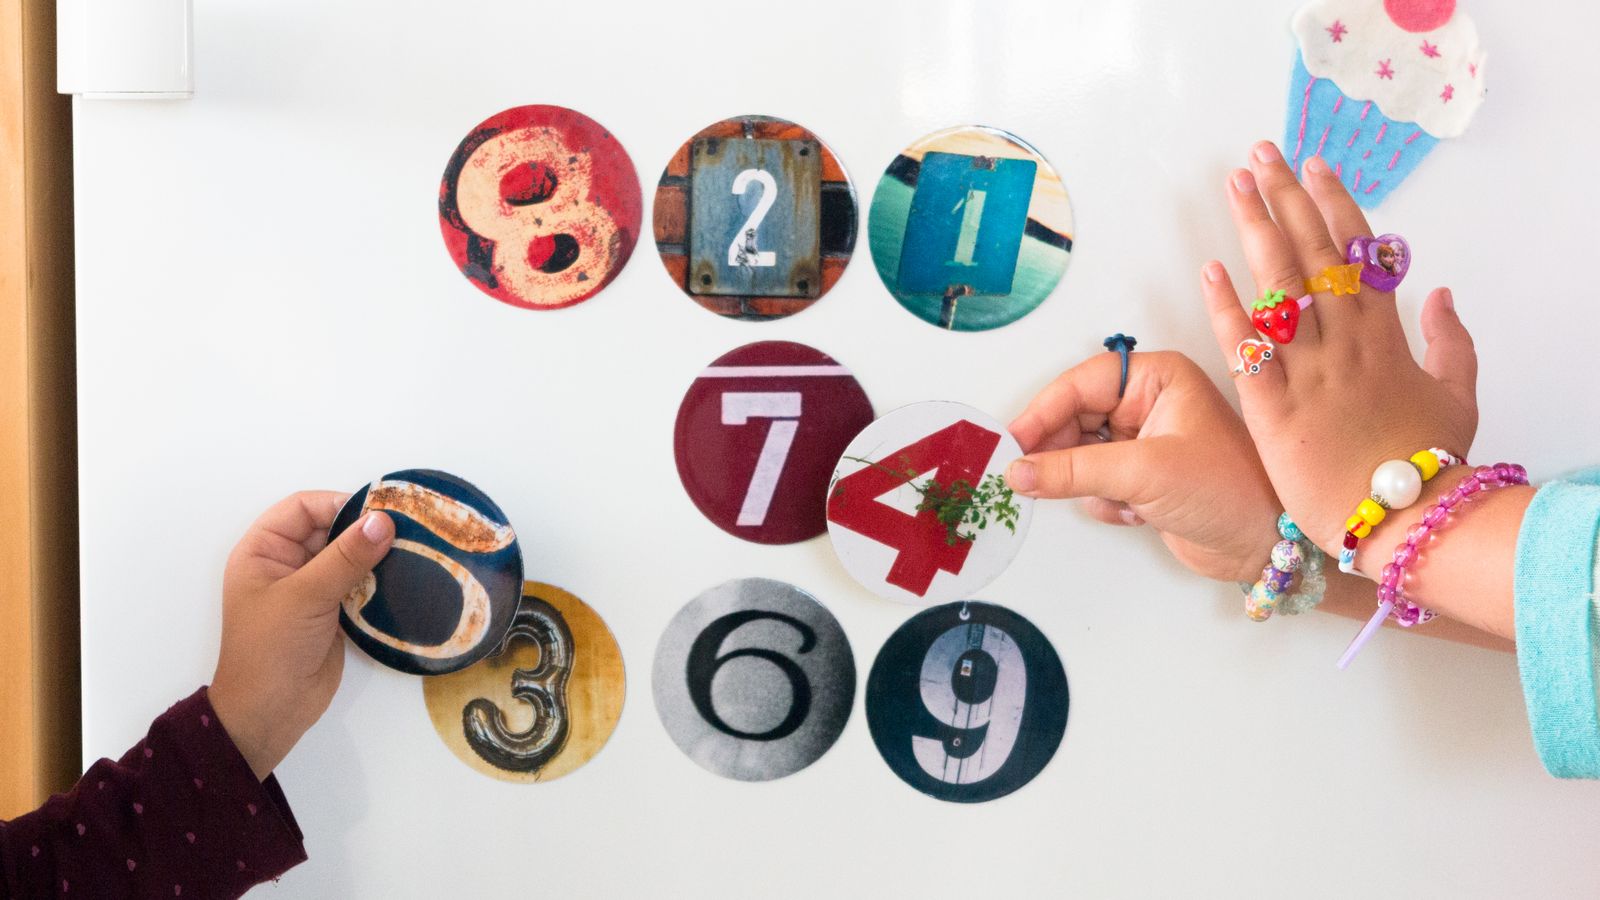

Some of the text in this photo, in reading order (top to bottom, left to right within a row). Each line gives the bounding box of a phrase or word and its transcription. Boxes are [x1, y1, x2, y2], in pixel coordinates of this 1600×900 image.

[456, 124, 621, 306] 8
[727, 168, 779, 267] 2
[945, 189, 987, 269] 1
[720, 391, 802, 527] 7
[827, 419, 1001, 597] 4
[461, 595, 576, 773] 3
[685, 610, 817, 742] 6
[910, 623, 1028, 785] 9
